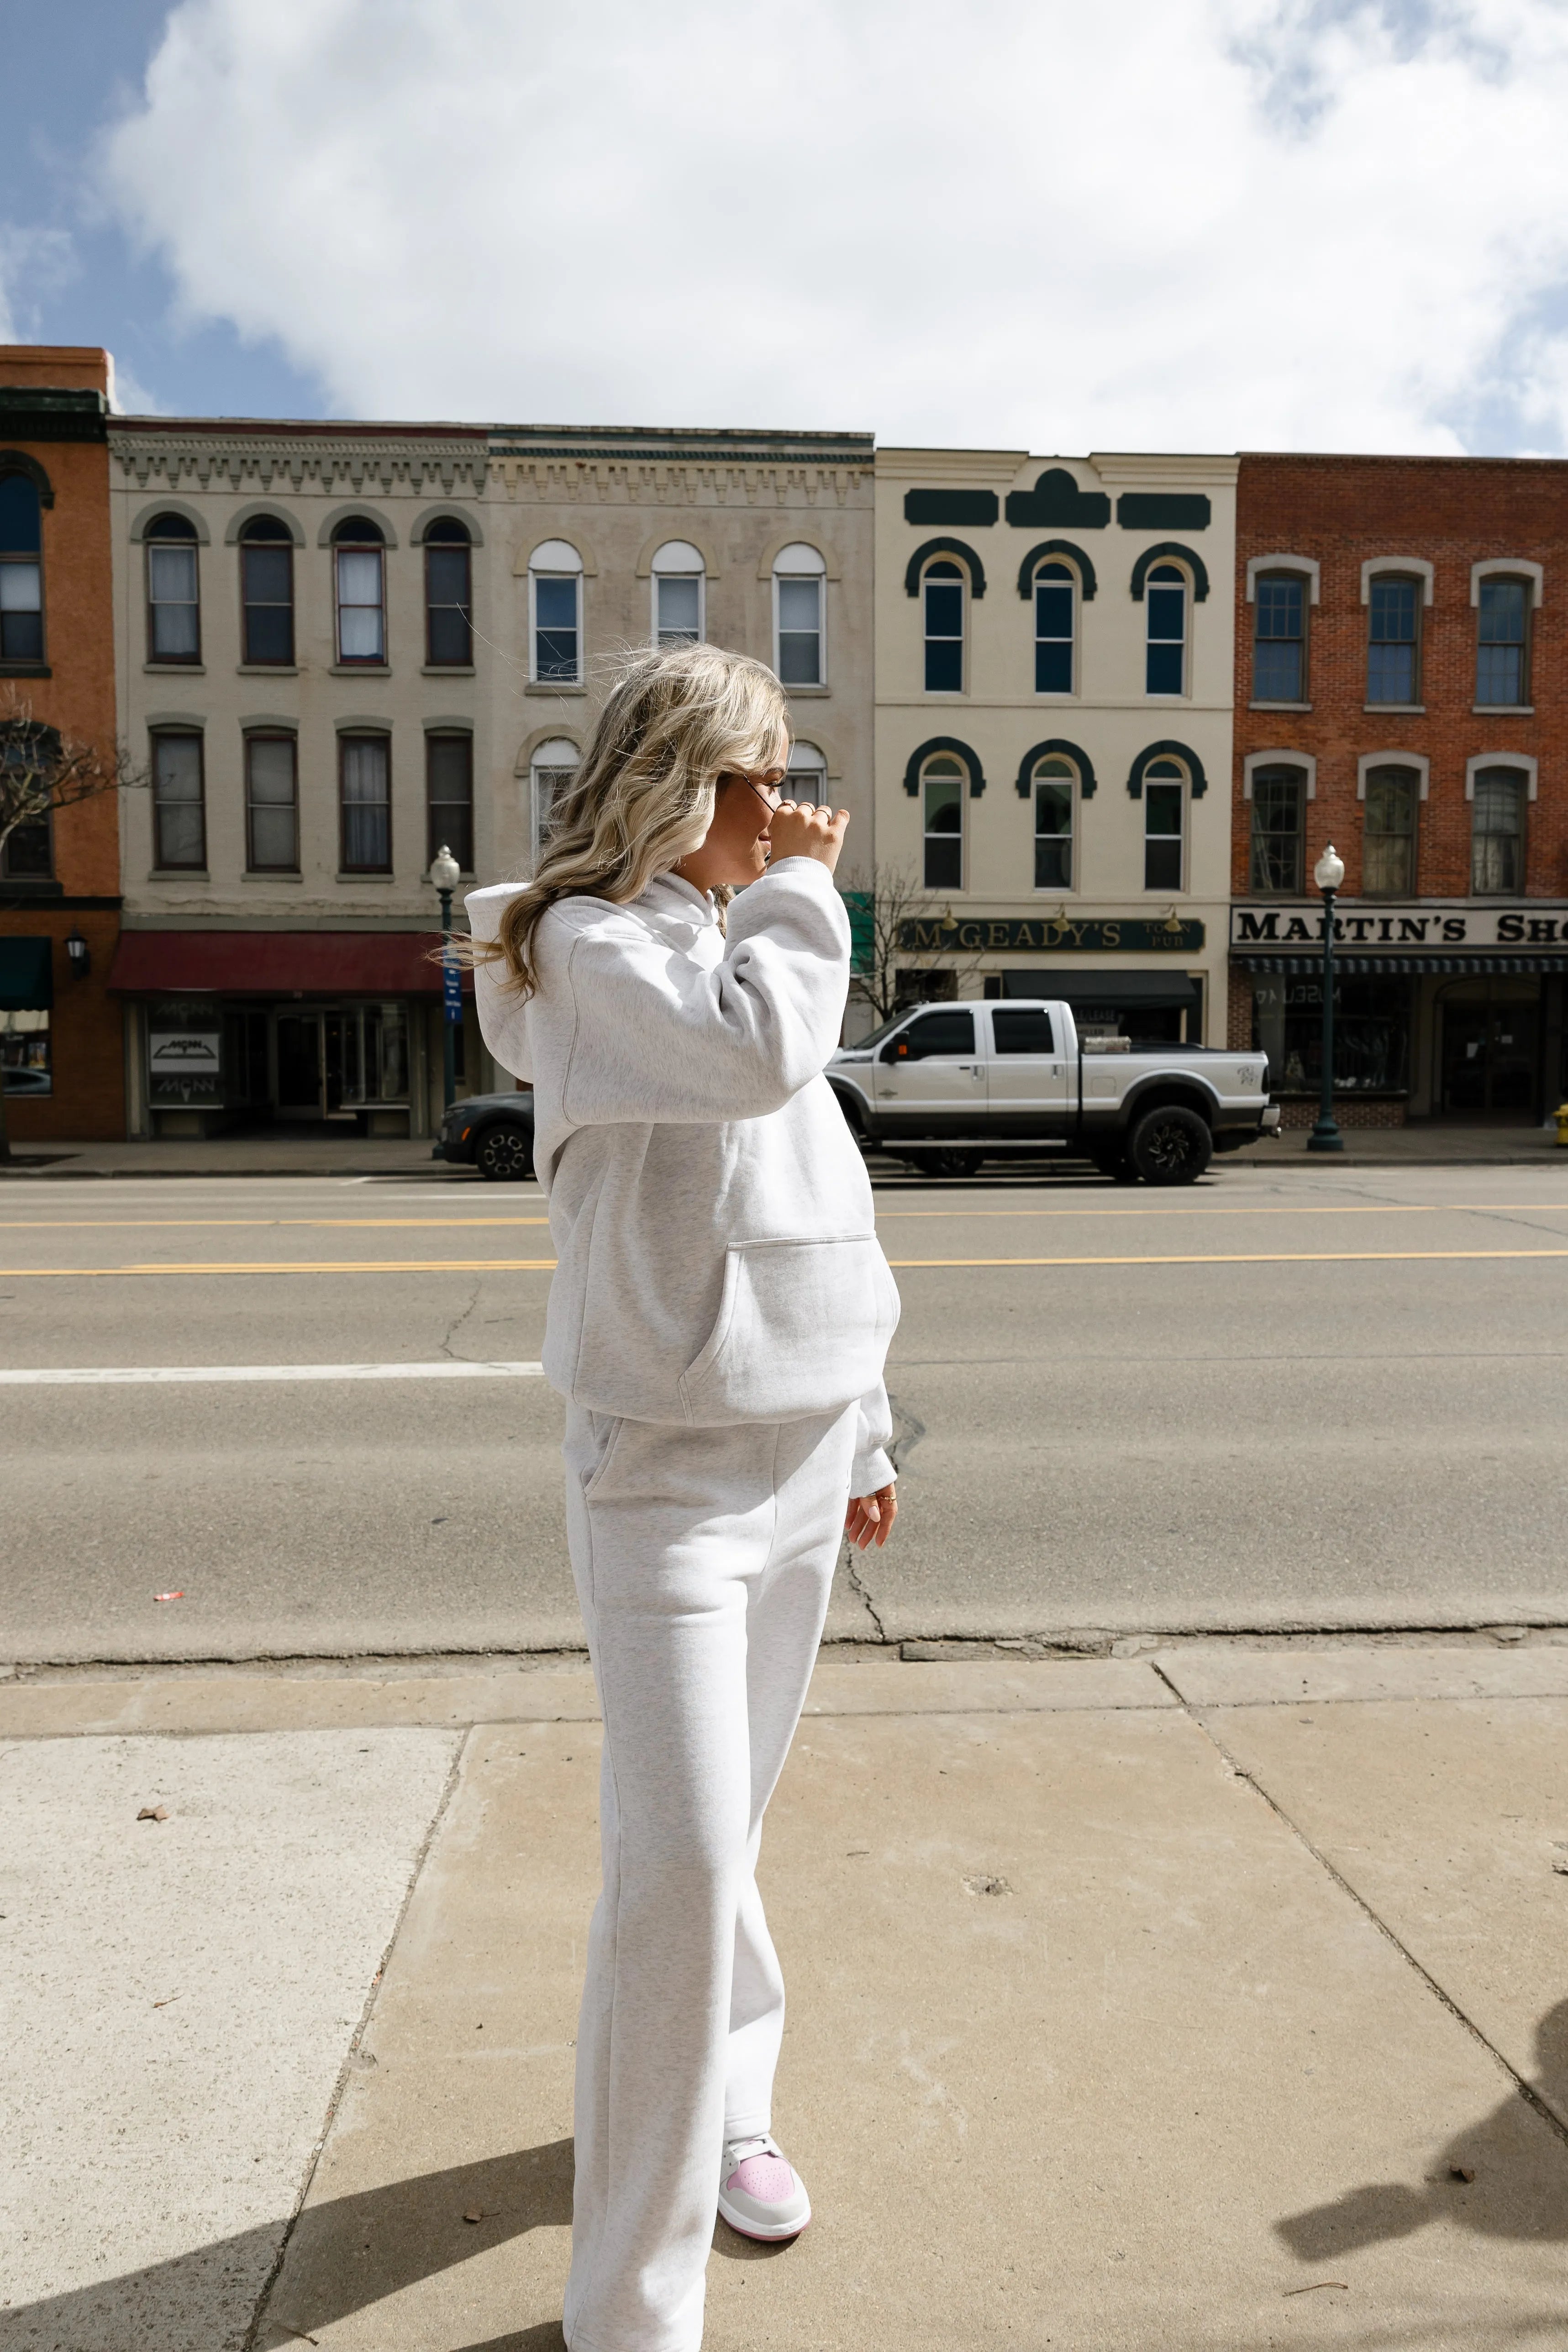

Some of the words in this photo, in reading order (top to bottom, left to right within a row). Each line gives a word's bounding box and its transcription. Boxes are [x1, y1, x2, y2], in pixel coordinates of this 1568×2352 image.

[1143, 922, 1191, 934] TON
[1237, 913, 1466, 941] MARTIN'S
[1497, 915, 1568, 942] SH
[1152, 936, 1184, 947] PUB
